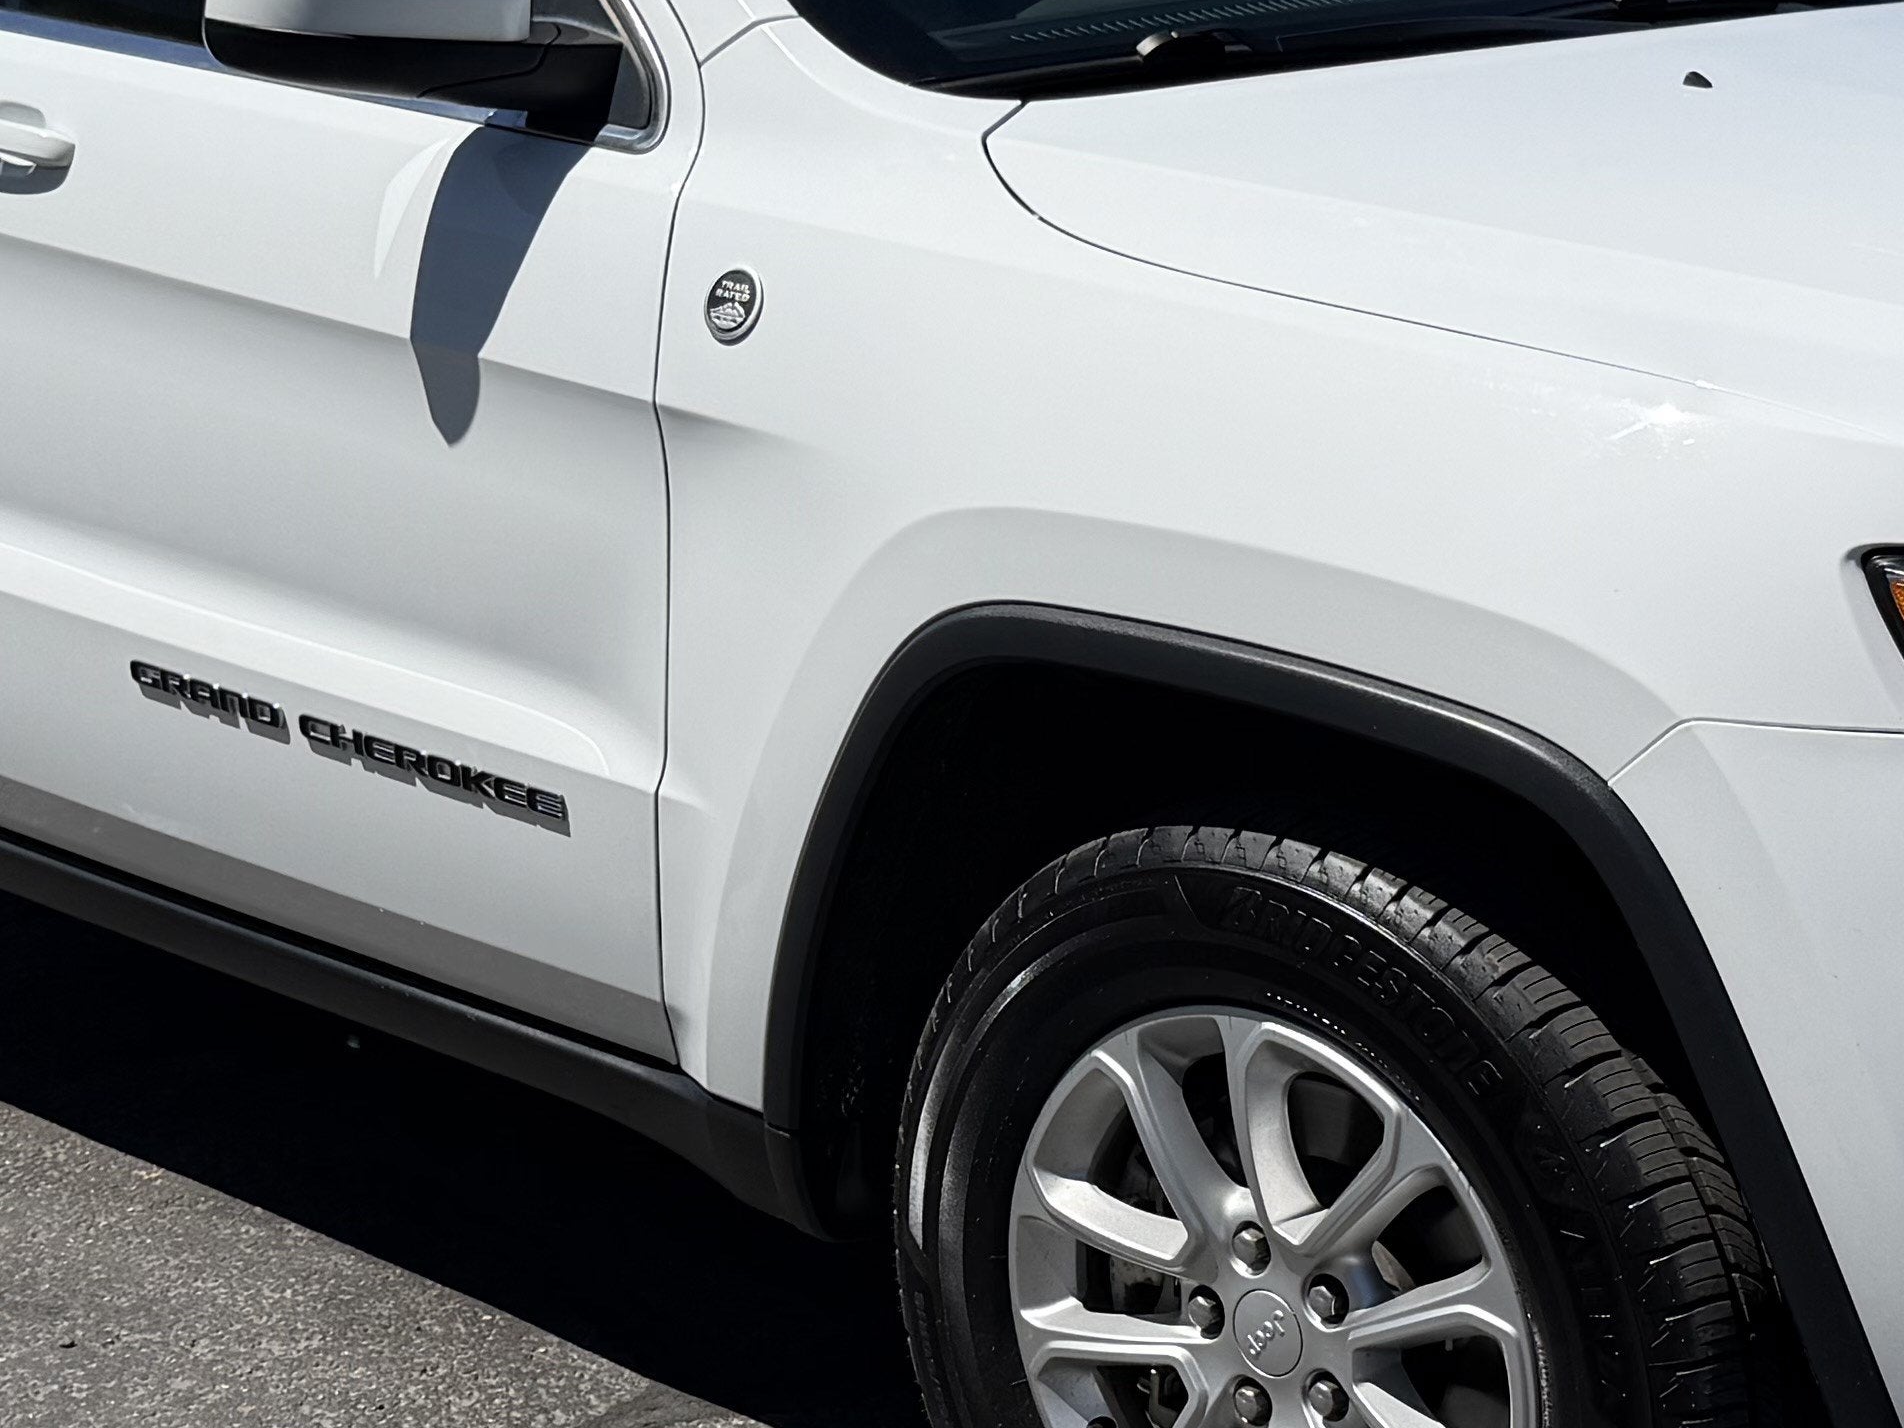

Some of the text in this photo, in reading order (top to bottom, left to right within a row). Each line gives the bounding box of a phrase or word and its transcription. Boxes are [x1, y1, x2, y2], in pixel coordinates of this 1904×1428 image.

[715, 288, 751, 303] RATED
[129, 659, 569, 822] GRAND CHEROKEE
